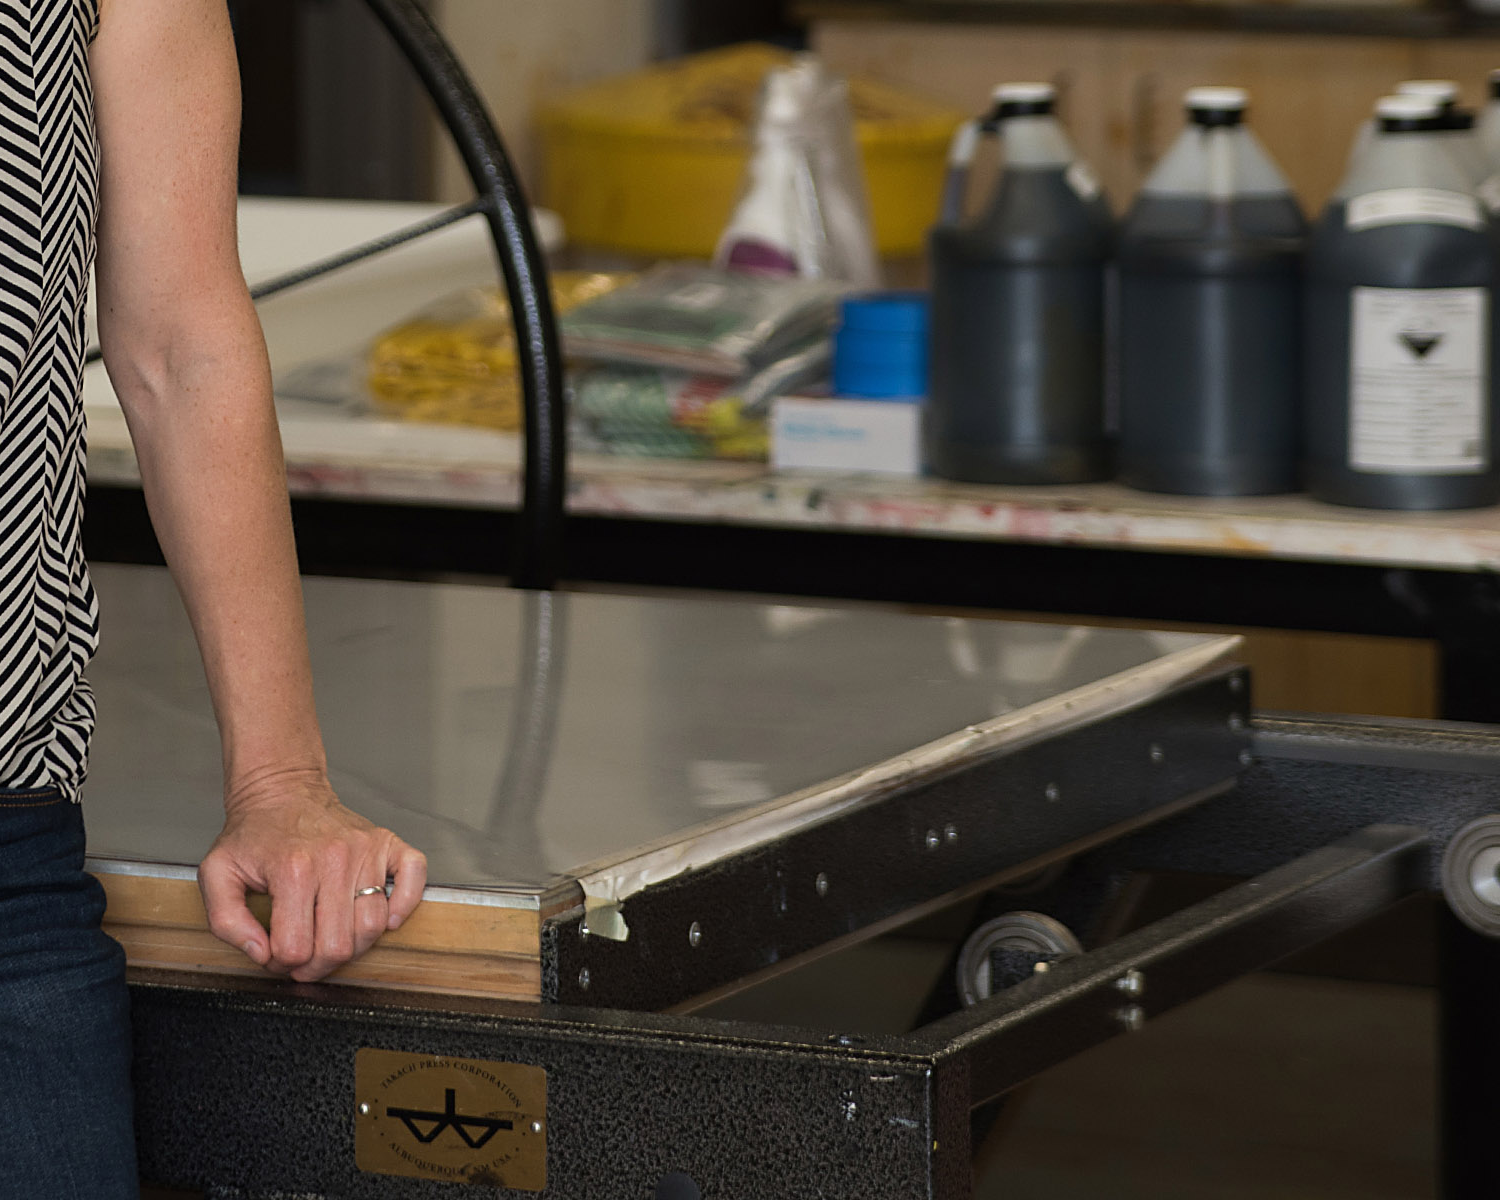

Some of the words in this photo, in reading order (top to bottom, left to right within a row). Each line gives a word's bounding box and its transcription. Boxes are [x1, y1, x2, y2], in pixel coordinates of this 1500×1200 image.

[381, 1063, 416, 1089] TAKACH
[420, 1060, 450, 1070] PRESS
[453, 1062, 522, 1108] CORPORATION
[493, 1153, 511, 1168] USA
